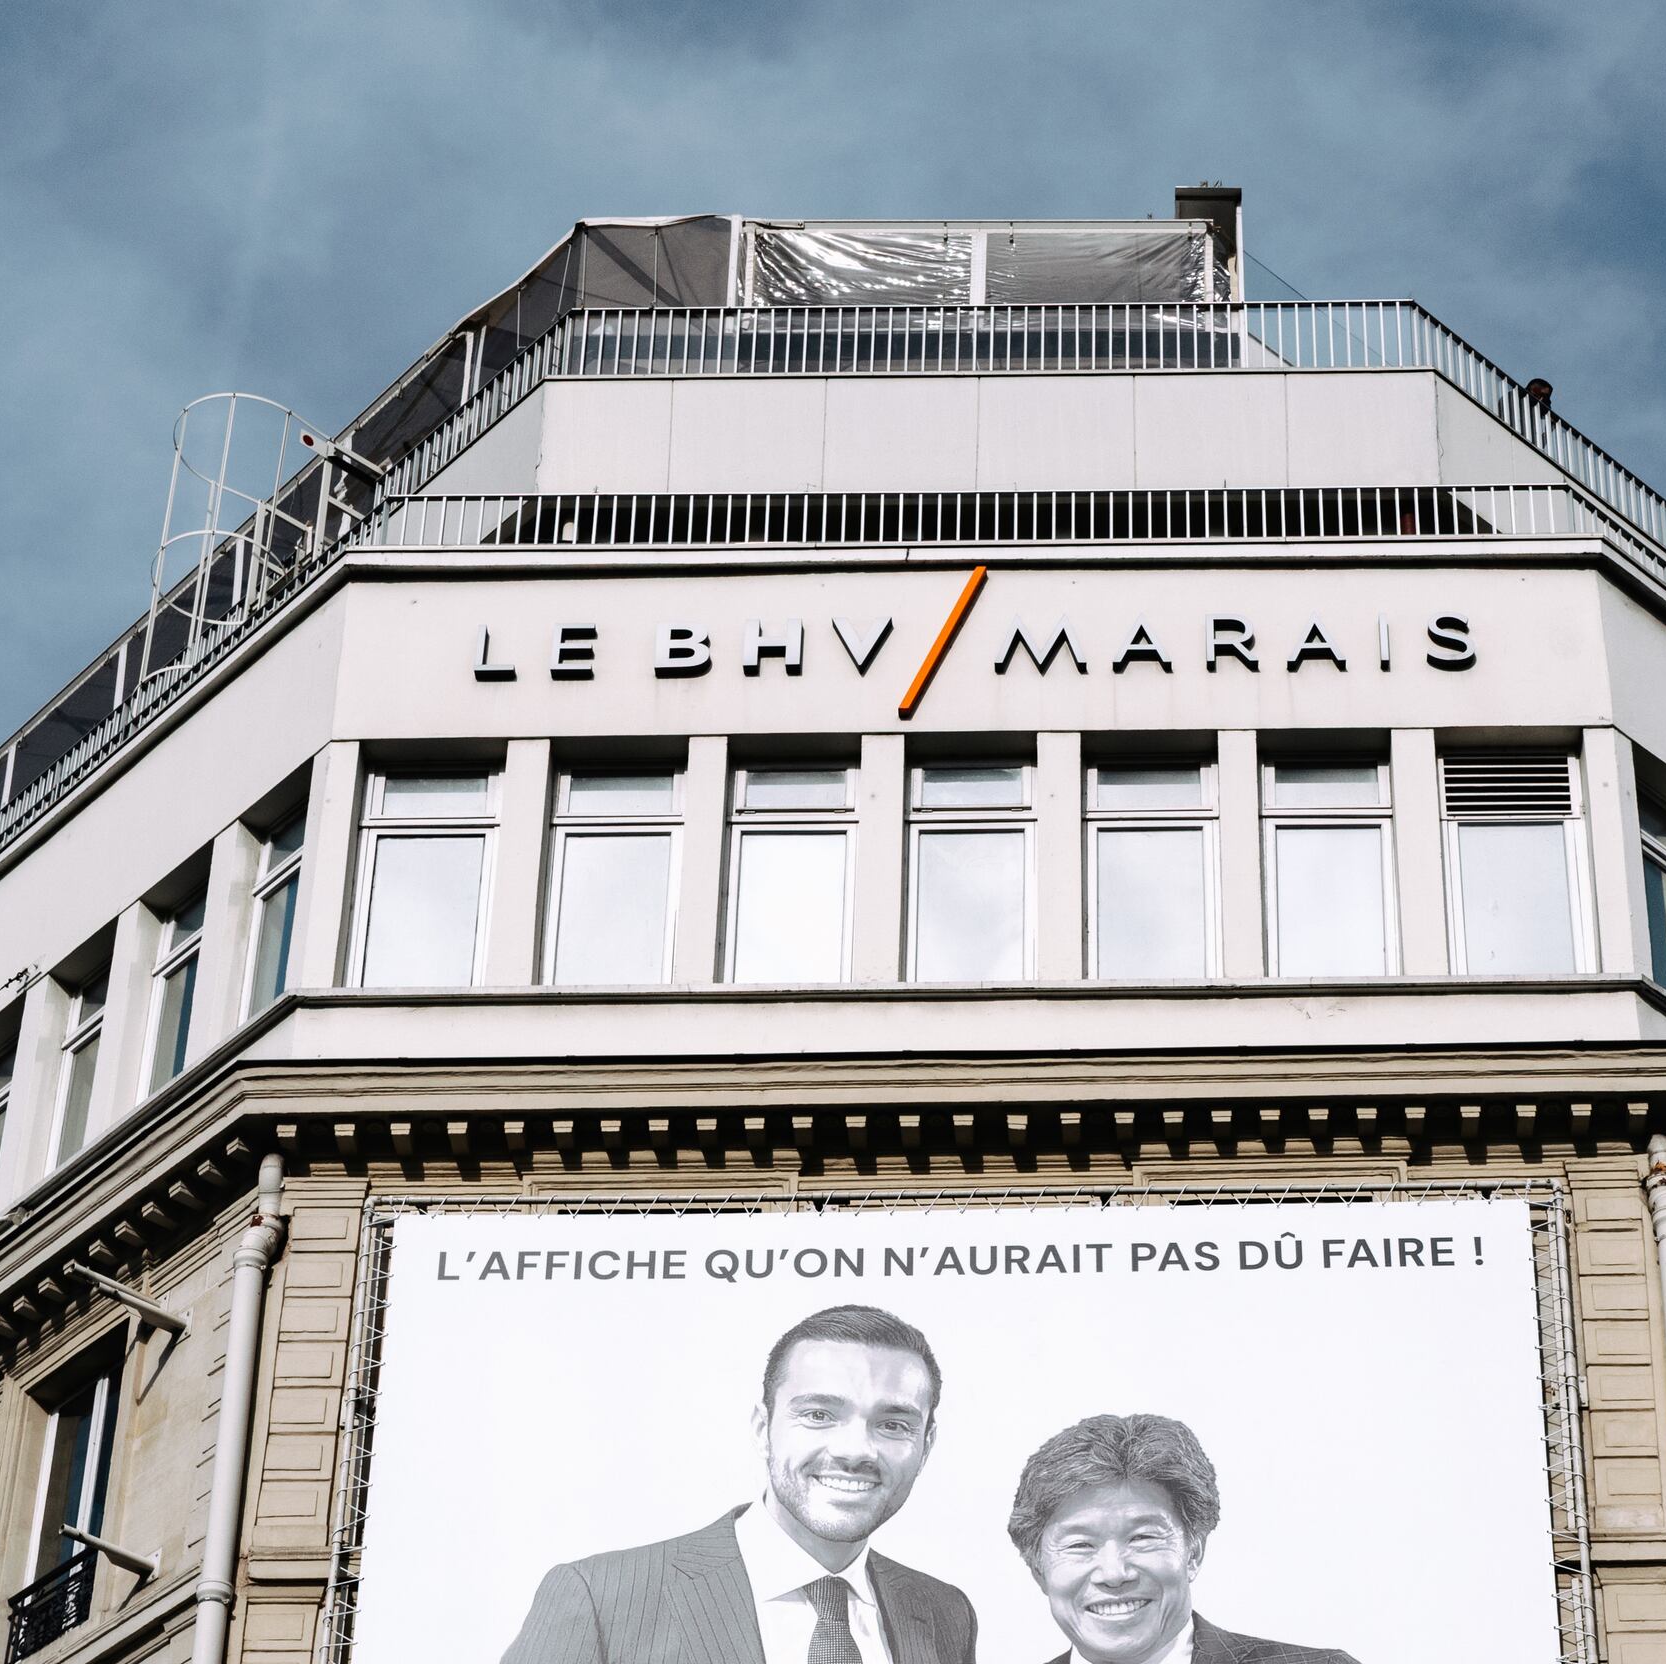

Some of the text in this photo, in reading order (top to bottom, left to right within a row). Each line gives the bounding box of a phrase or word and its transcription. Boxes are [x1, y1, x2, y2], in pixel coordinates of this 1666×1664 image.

[474, 611, 1478, 682] LE BHV MARAIS
[437, 1250, 688, 1281] L’AFFICHE
[704, 1247, 865, 1283] QU’ON
[883, 1243, 1113, 1278] N’AURAIT
[1130, 1241, 1221, 1273] PAS
[1238, 1231, 1304, 1271] DÛ
[1322, 1236, 1457, 1270] FAIRE
